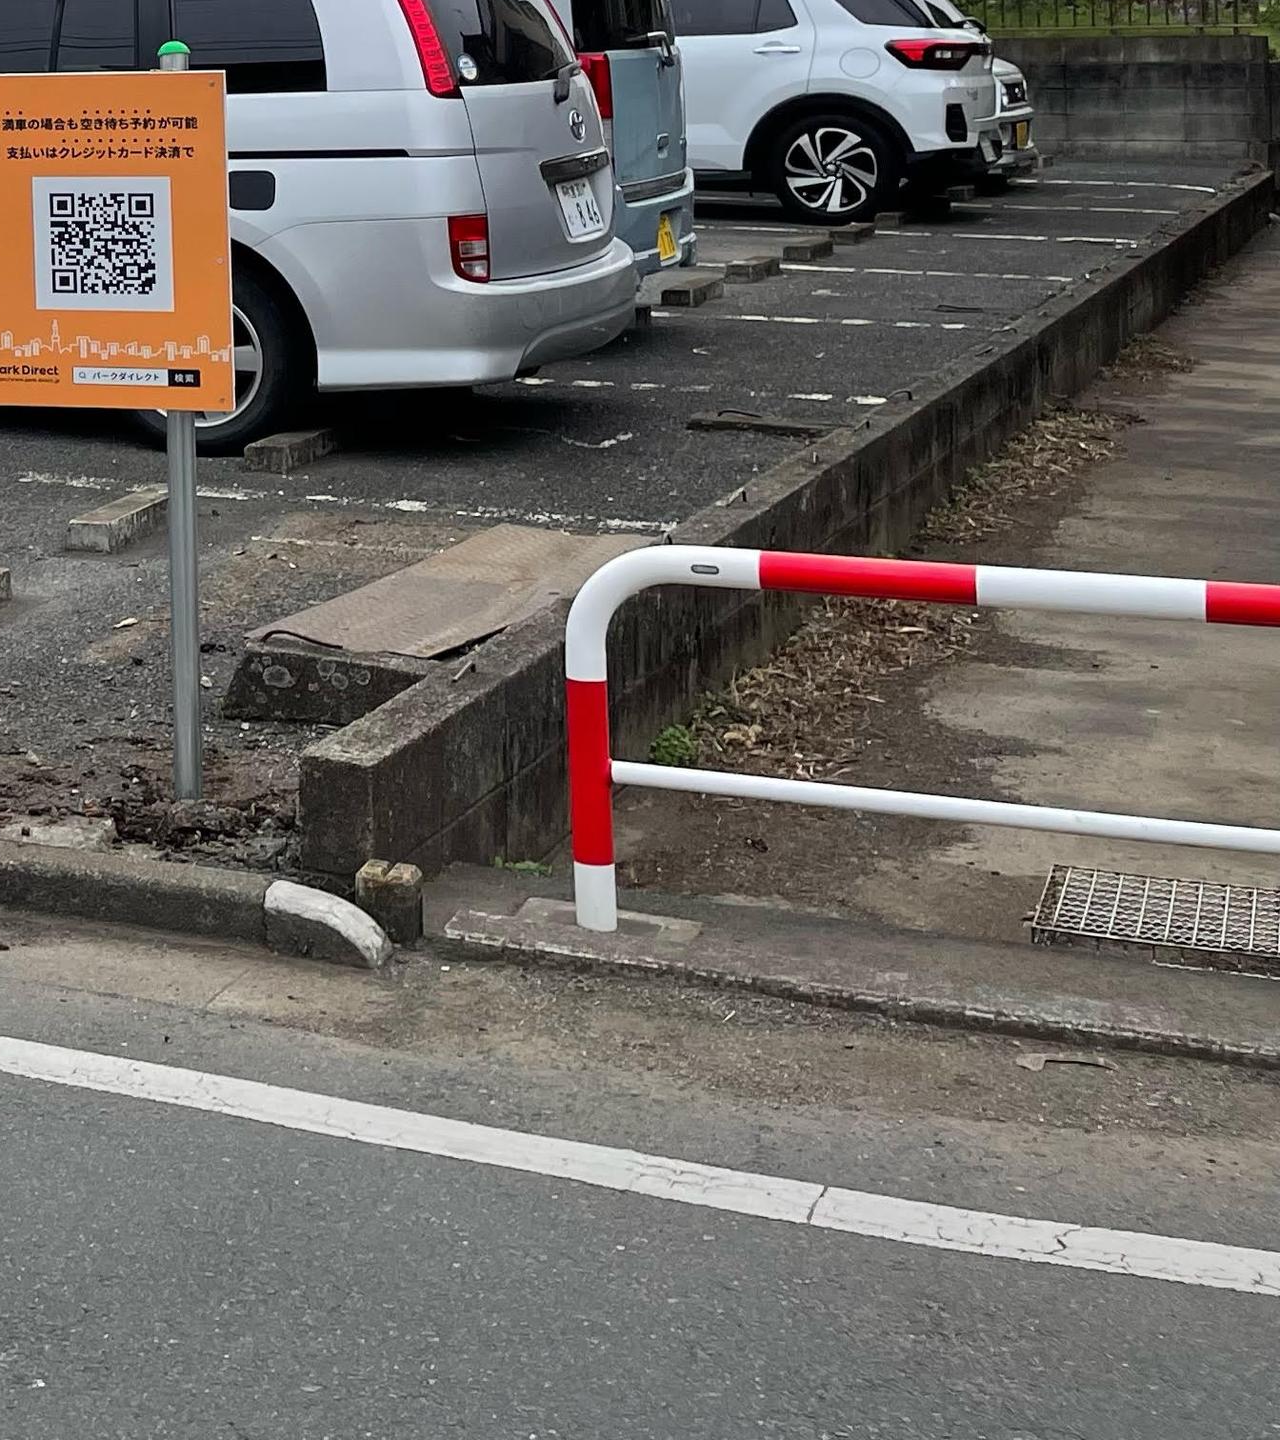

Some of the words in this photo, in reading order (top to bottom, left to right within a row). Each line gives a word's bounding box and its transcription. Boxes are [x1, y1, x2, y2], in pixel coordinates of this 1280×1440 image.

[7, 146, 194, 159] 支払いはクレジットカード決済で
[21, 365, 59, 376] Direct
[92, 371, 160, 381] パークダイレクト
